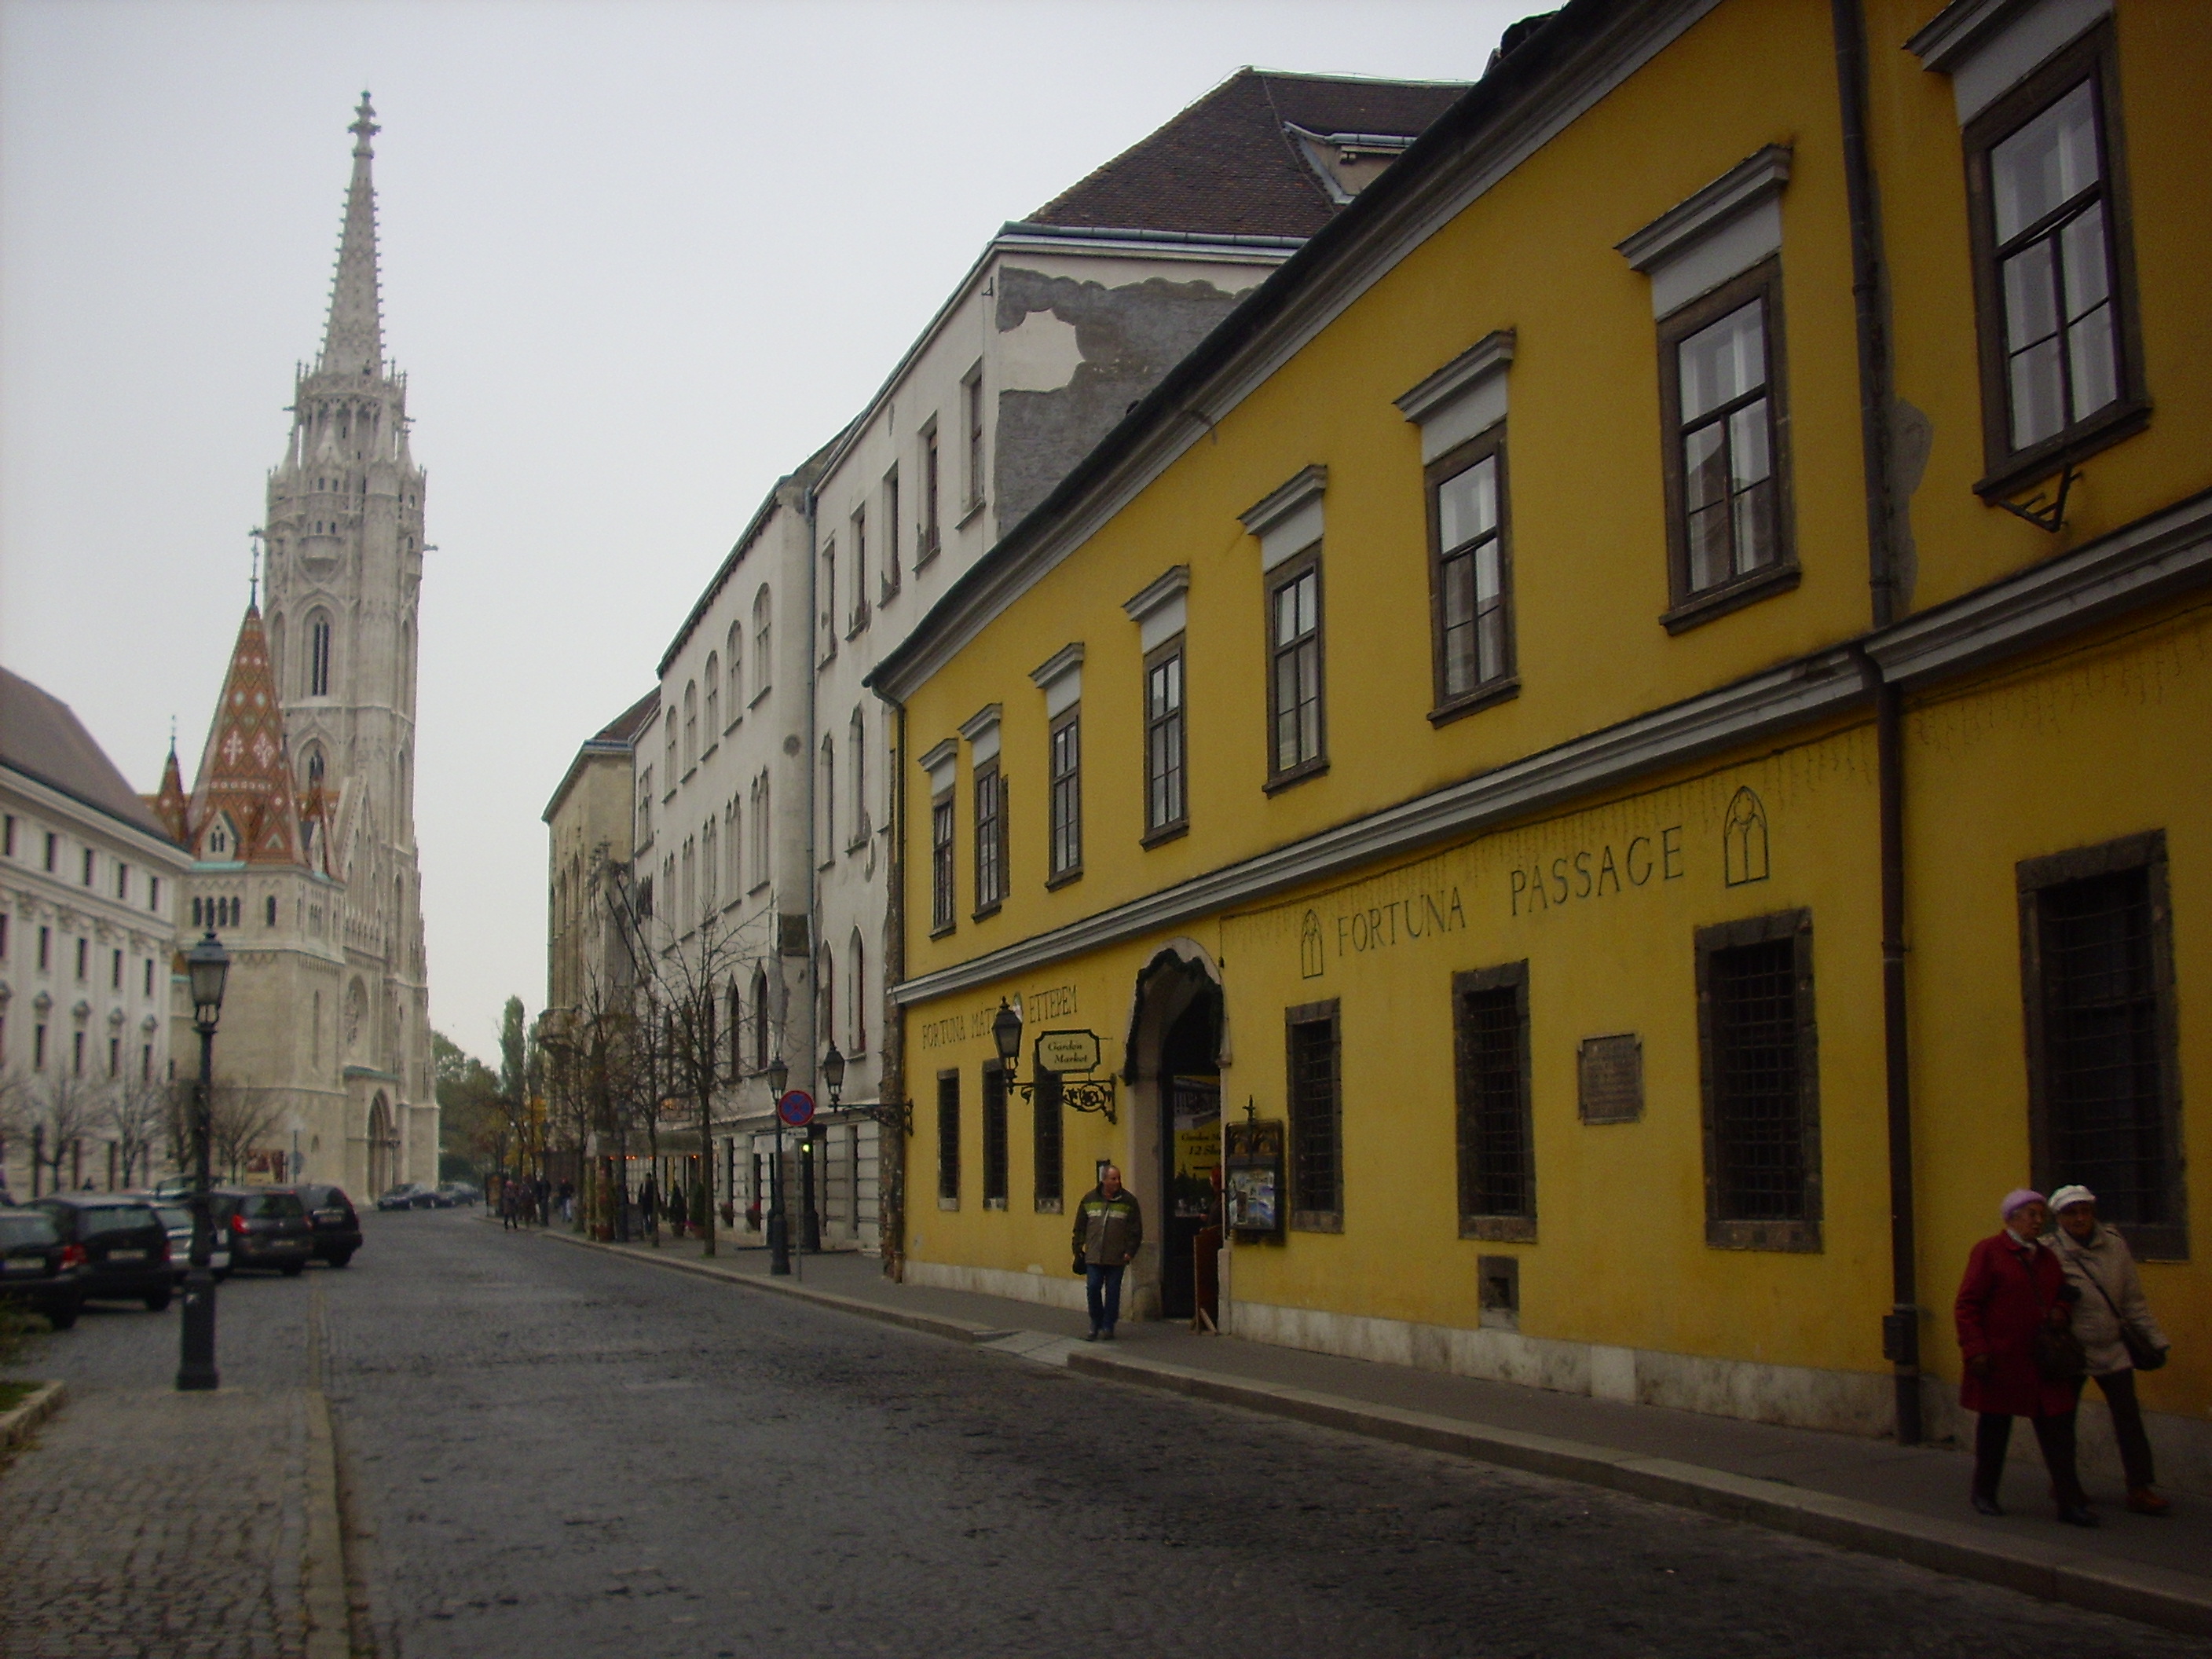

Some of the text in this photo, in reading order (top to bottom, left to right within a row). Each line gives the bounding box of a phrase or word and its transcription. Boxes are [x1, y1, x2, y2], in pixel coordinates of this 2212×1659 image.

[1337, 825, 1685, 957] FORTUNA PASSAGE
[922, 1015, 966, 1050] FORTUNA
